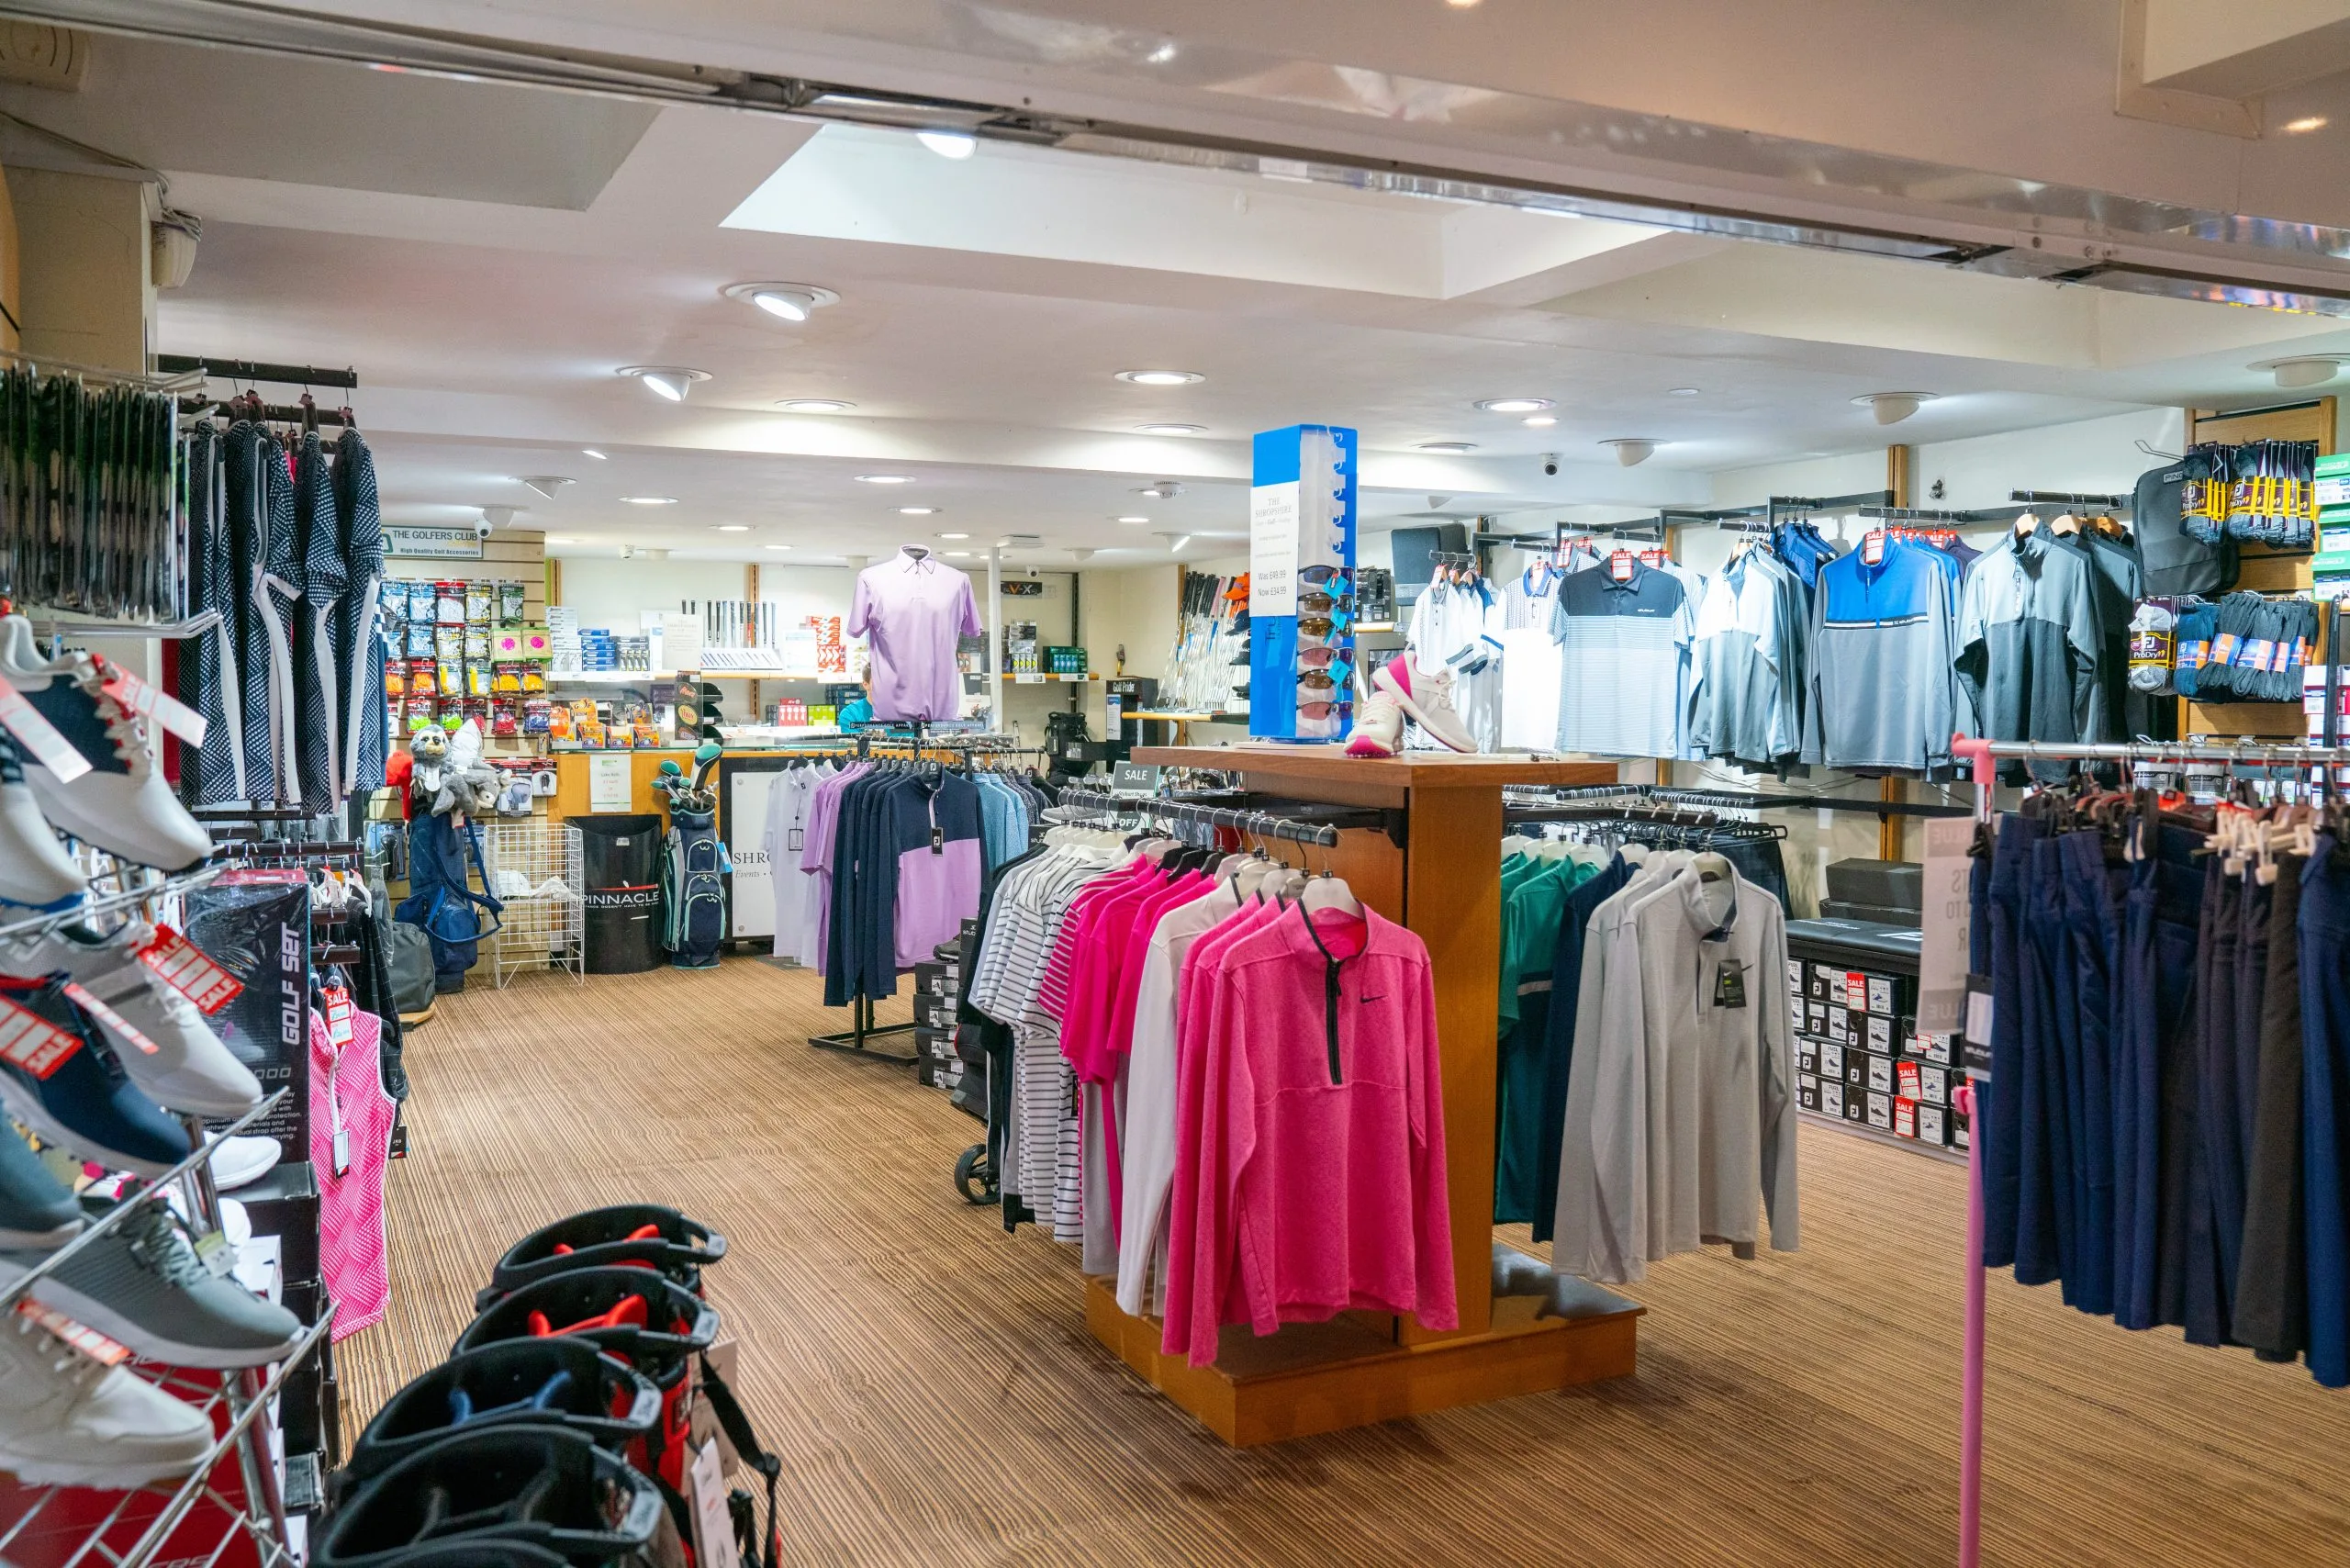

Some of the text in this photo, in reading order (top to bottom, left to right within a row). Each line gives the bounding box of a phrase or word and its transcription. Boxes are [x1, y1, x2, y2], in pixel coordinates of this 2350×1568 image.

[392, 530, 477, 541] THE GOLFERS CLUB
[1258, 572, 1269, 581] Was
[1258, 588, 1270, 597] Now
[2143, 636, 2155, 648] FJ
[2133, 651, 2158, 659] ProDry
[1113, 681, 1123, 692] Golf
[1124, 769, 1147, 780] SALE
[1119, 818, 1138, 827] OFF
[734, 869, 760, 879] Events
[583, 890, 660, 904] PINNACLE
[281, 921, 300, 1046] GOLF SET
[1813, 981, 1822, 996] FJ
[1847, 980, 1864, 988] SALE
[197, 977, 237, 1011] SALE
[328, 991, 348, 1007] SALE
[1812, 1019, 1821, 1033] FJ
[1849, 1032, 1858, 1046] FJ
[25, 1033, 73, 1073] SALE
[1802, 1056, 1812, 1070] FJ
[253, 1067, 292, 1080] 000
[1850, 1068, 1860, 1082] FJ
[1899, 1069, 1917, 1077] SALE
[1804, 1092, 1813, 1106] FJ
[1850, 1103, 1859, 1118] FJ
[1896, 1103, 1913, 1112] SALE
